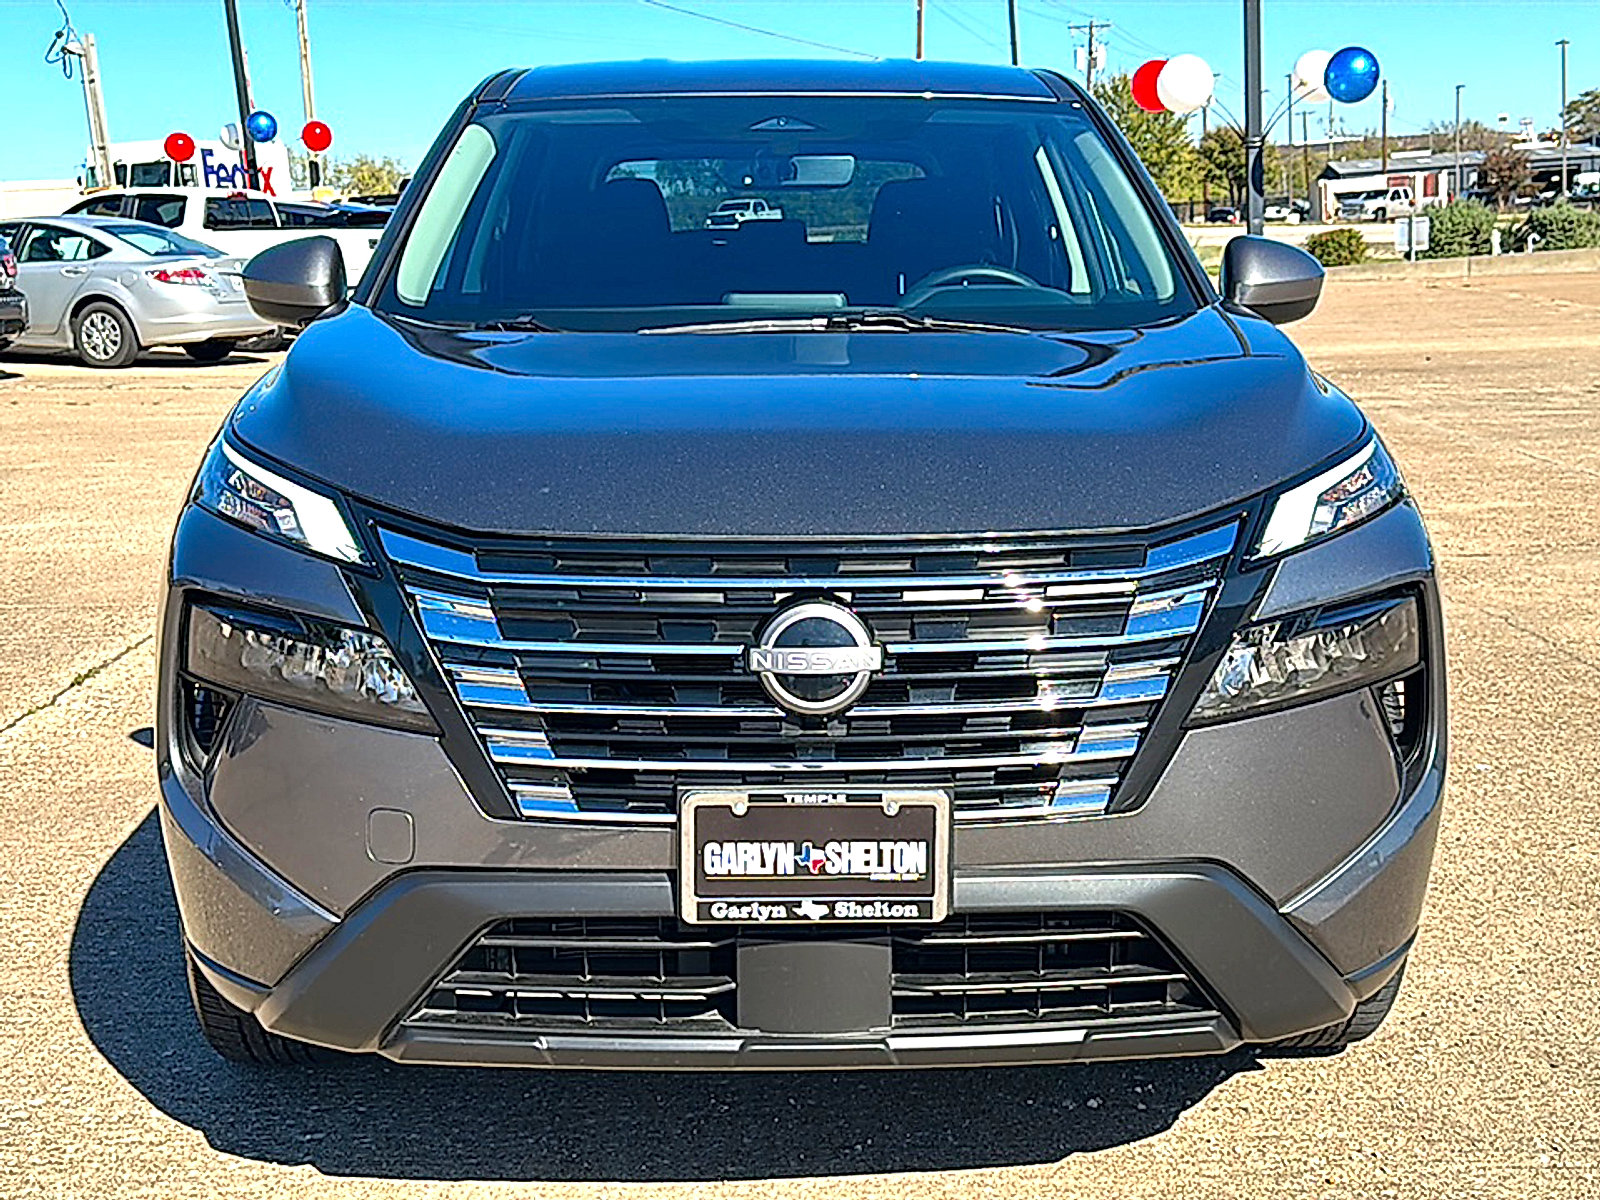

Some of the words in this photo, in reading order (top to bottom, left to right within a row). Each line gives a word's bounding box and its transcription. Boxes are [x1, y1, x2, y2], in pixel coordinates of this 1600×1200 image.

[200, 148, 277, 197] Fedx
[751, 651, 874, 671] NISSAN
[783, 793, 847, 804] TEMPLE
[703, 841, 795, 875] GARLYN
[824, 840, 927, 874] SHELTON
[710, 902, 788, 922] Garlyn
[834, 901, 920, 918] Shelton
